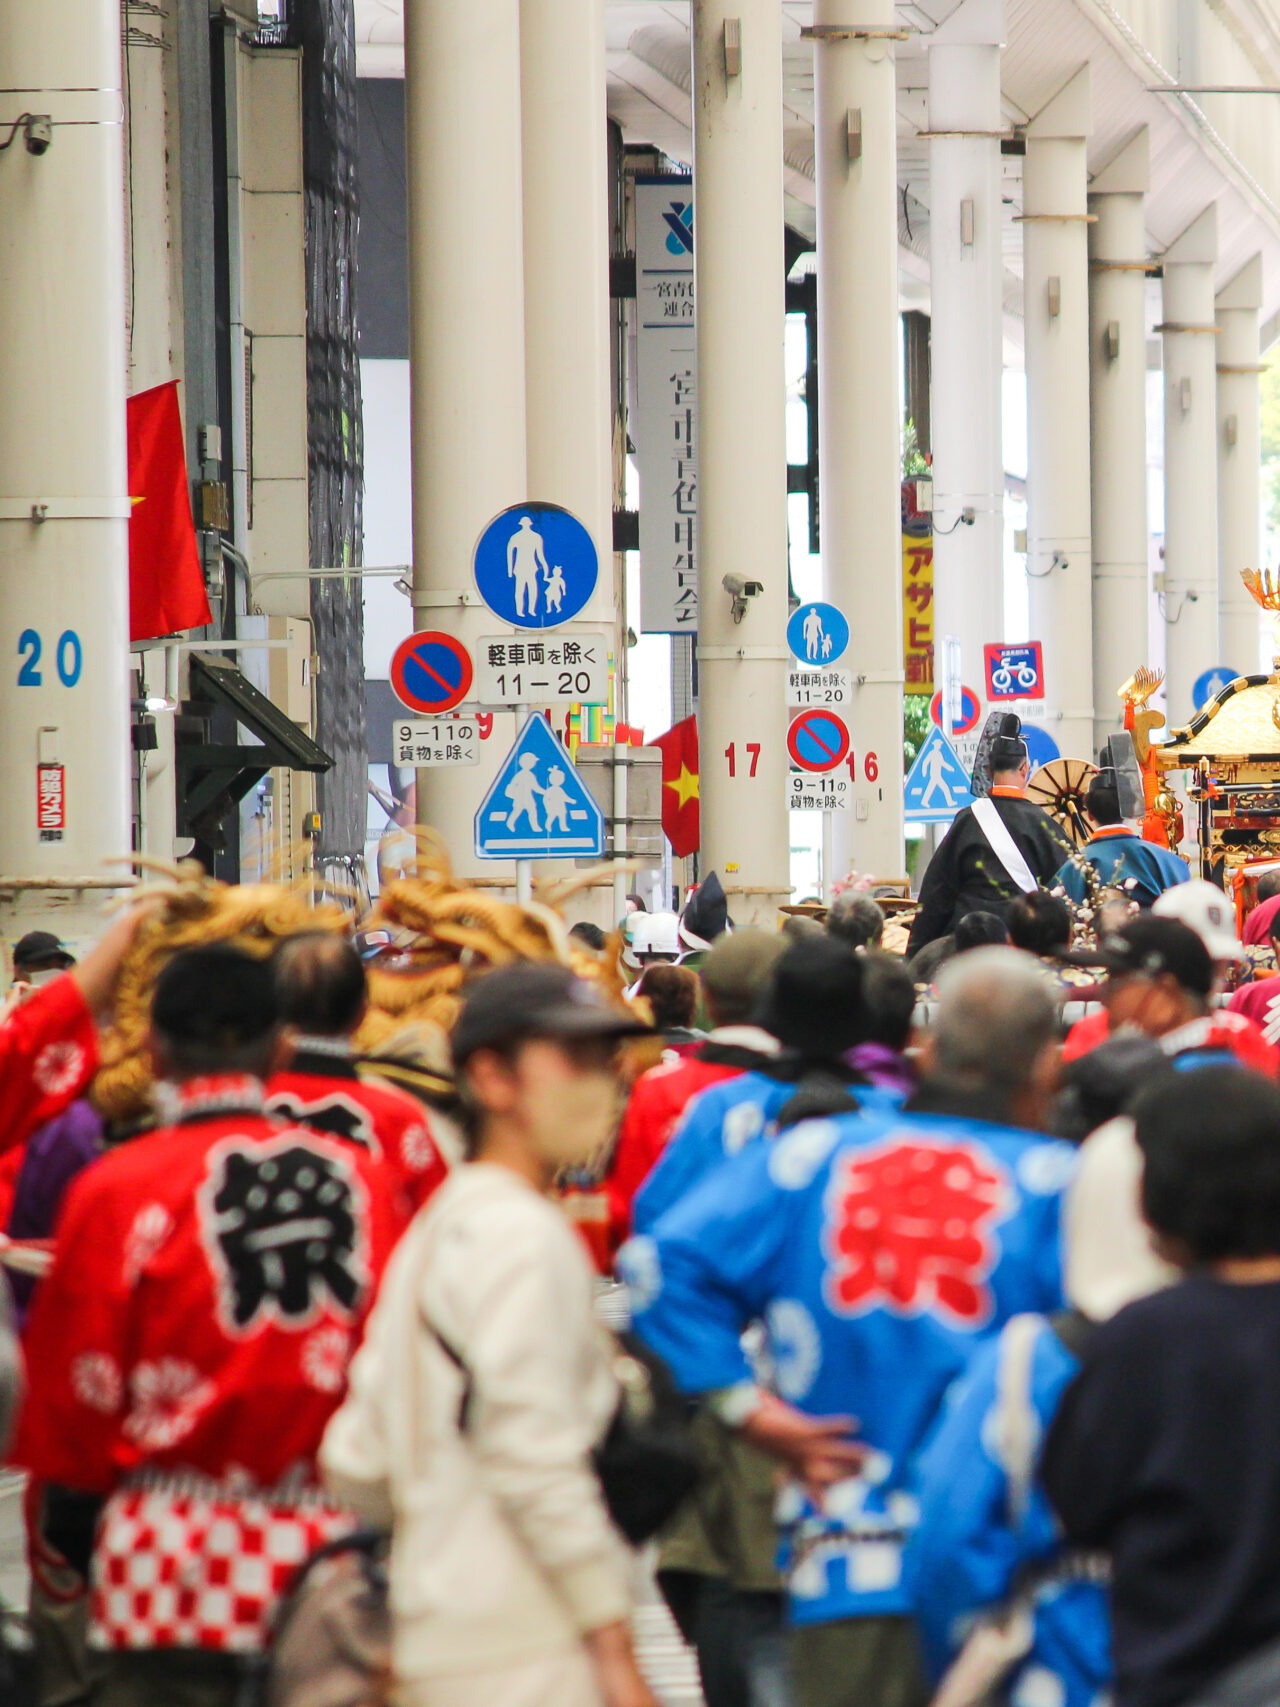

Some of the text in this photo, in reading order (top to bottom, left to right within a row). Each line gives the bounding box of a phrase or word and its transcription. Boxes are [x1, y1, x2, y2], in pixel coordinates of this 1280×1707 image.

[17, 628, 83, 688] 20
[487, 642, 597, 668] 軽車両を除く
[496, 671, 591, 696] 11-20
[789, 672, 846, 688] 軽車両を除く
[796, 689, 843, 703] 11-20
[399, 725, 474, 742] 9-11の
[399, 745, 474, 762] 貨物を除く
[724, 742, 761, 778] 17
[845, 751, 879, 782] 16
[793, 778, 847, 793] 9-11の
[790, 795, 846, 809] 貨物を除く
[210, 1142, 362, 1327] 祭
[833, 1140, 1002, 1325] 祭
